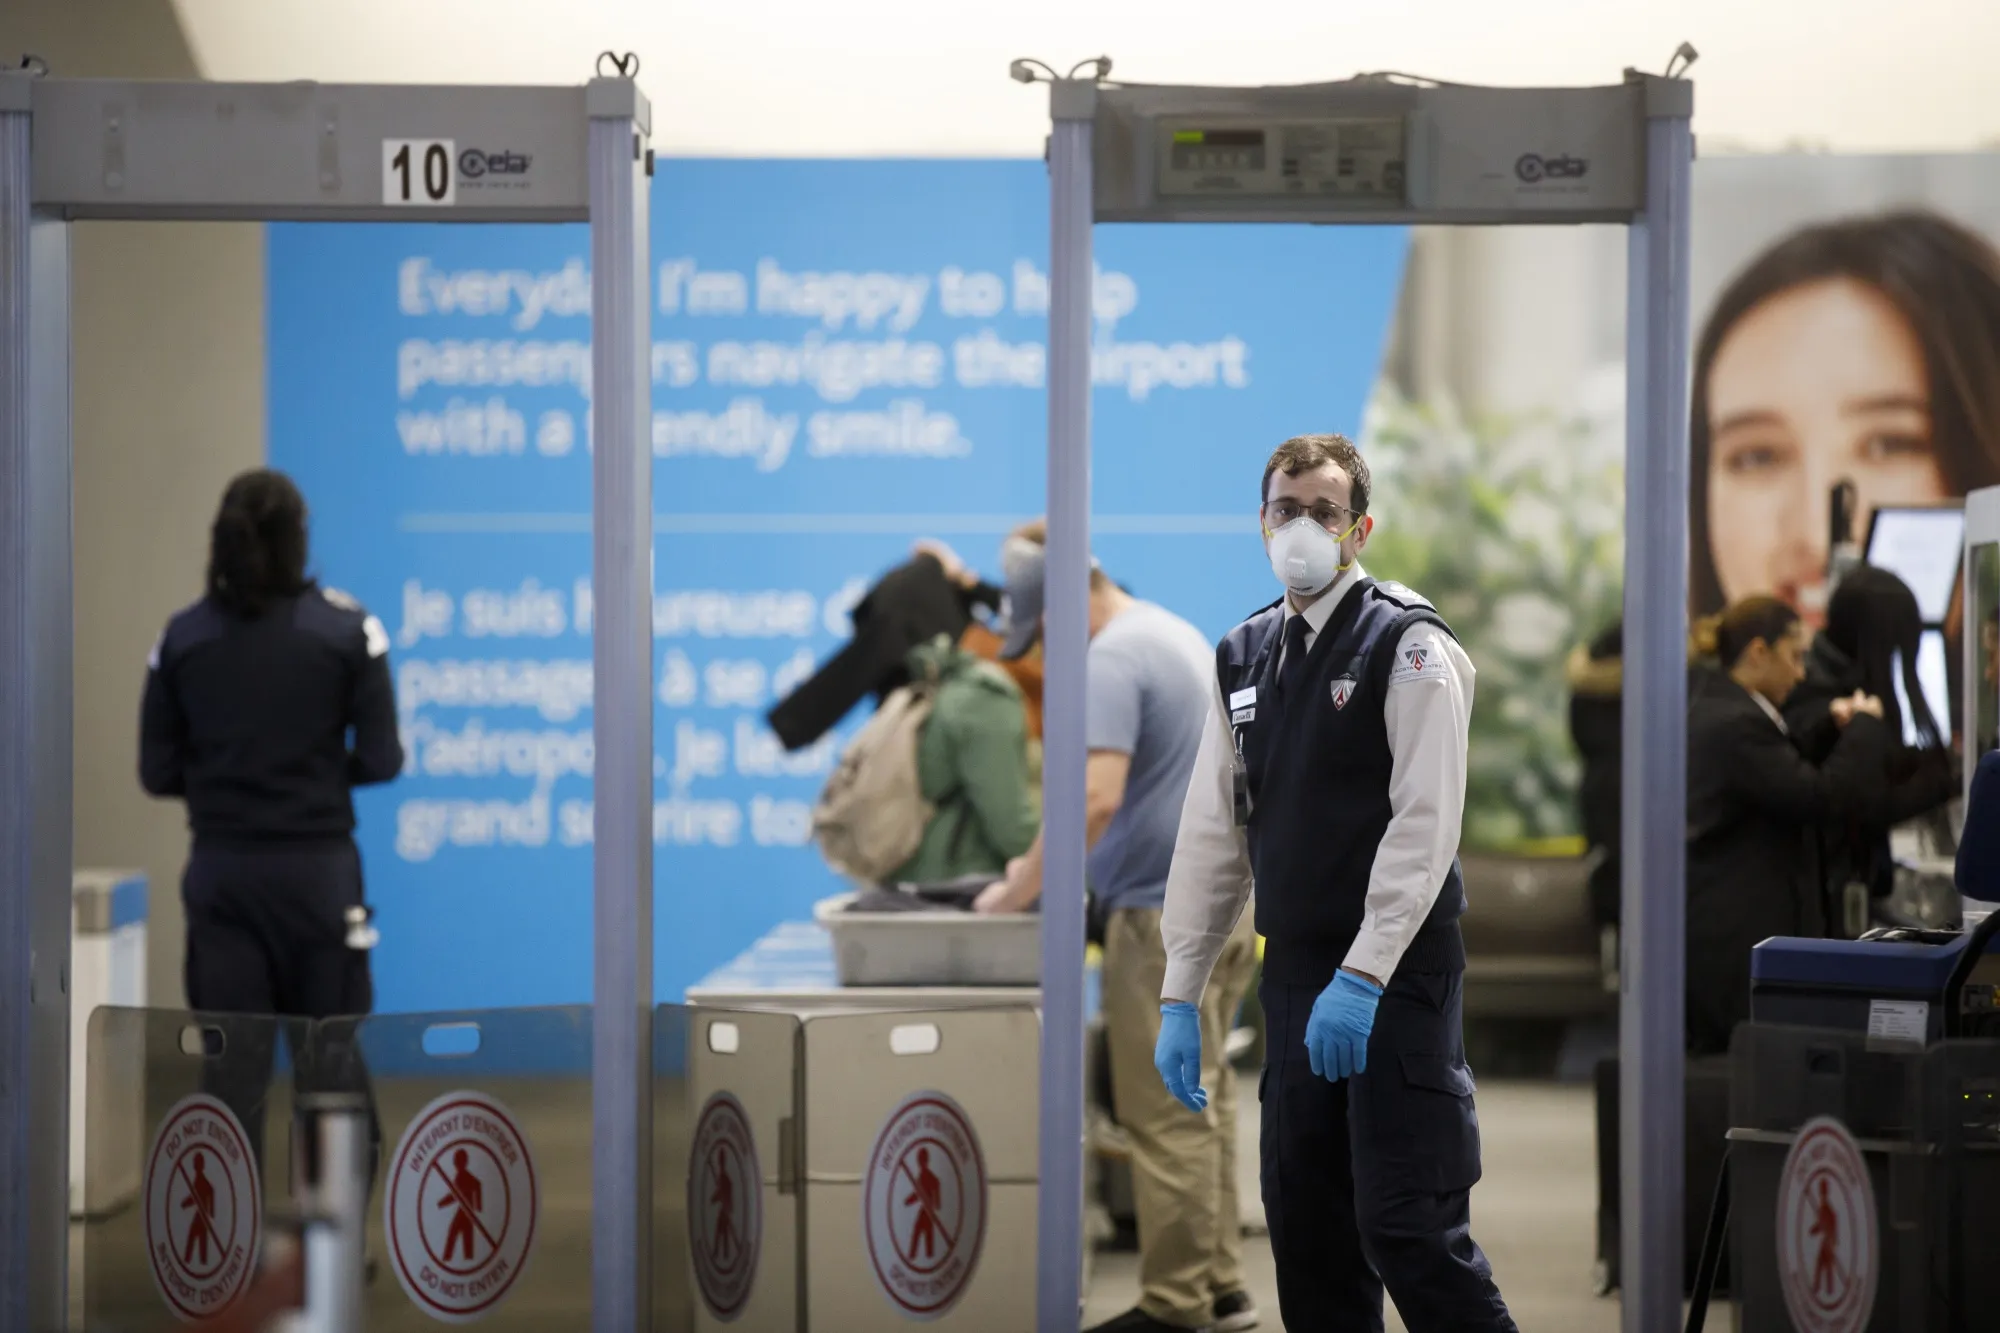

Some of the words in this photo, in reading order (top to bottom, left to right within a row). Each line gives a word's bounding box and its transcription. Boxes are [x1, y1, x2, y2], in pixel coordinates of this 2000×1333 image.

[392, 143, 449, 201] 10
[399, 256, 592, 332] Everyd
[658, 257, 748, 317] I'm
[756, 256, 929, 333] happy
[939, 265, 1005, 318] to
[398, 337, 698, 400] passenrs
[707, 330, 944, 402] navigate
[954, 328, 1047, 388] the
[1091, 331, 1250, 403] irport
[395, 396, 526, 457] with
[536, 409, 575, 457] a
[587, 398, 799, 473] endly
[463, 576, 567, 638] suis
[704, 658, 766, 708] se
[395, 789, 551, 862] grand
[559, 790, 741, 846] srire
[166, 1131, 181, 1159] DO
[182, 1118, 205, 1140] NOT
[410, 1114, 459, 1173] INTERDIT
[462, 1114, 518, 1167] D'ENTRER
[420, 1265, 438, 1289] DO
[439, 1279, 464, 1299] NOT
[468, 1259, 509, 1297] ENTER
